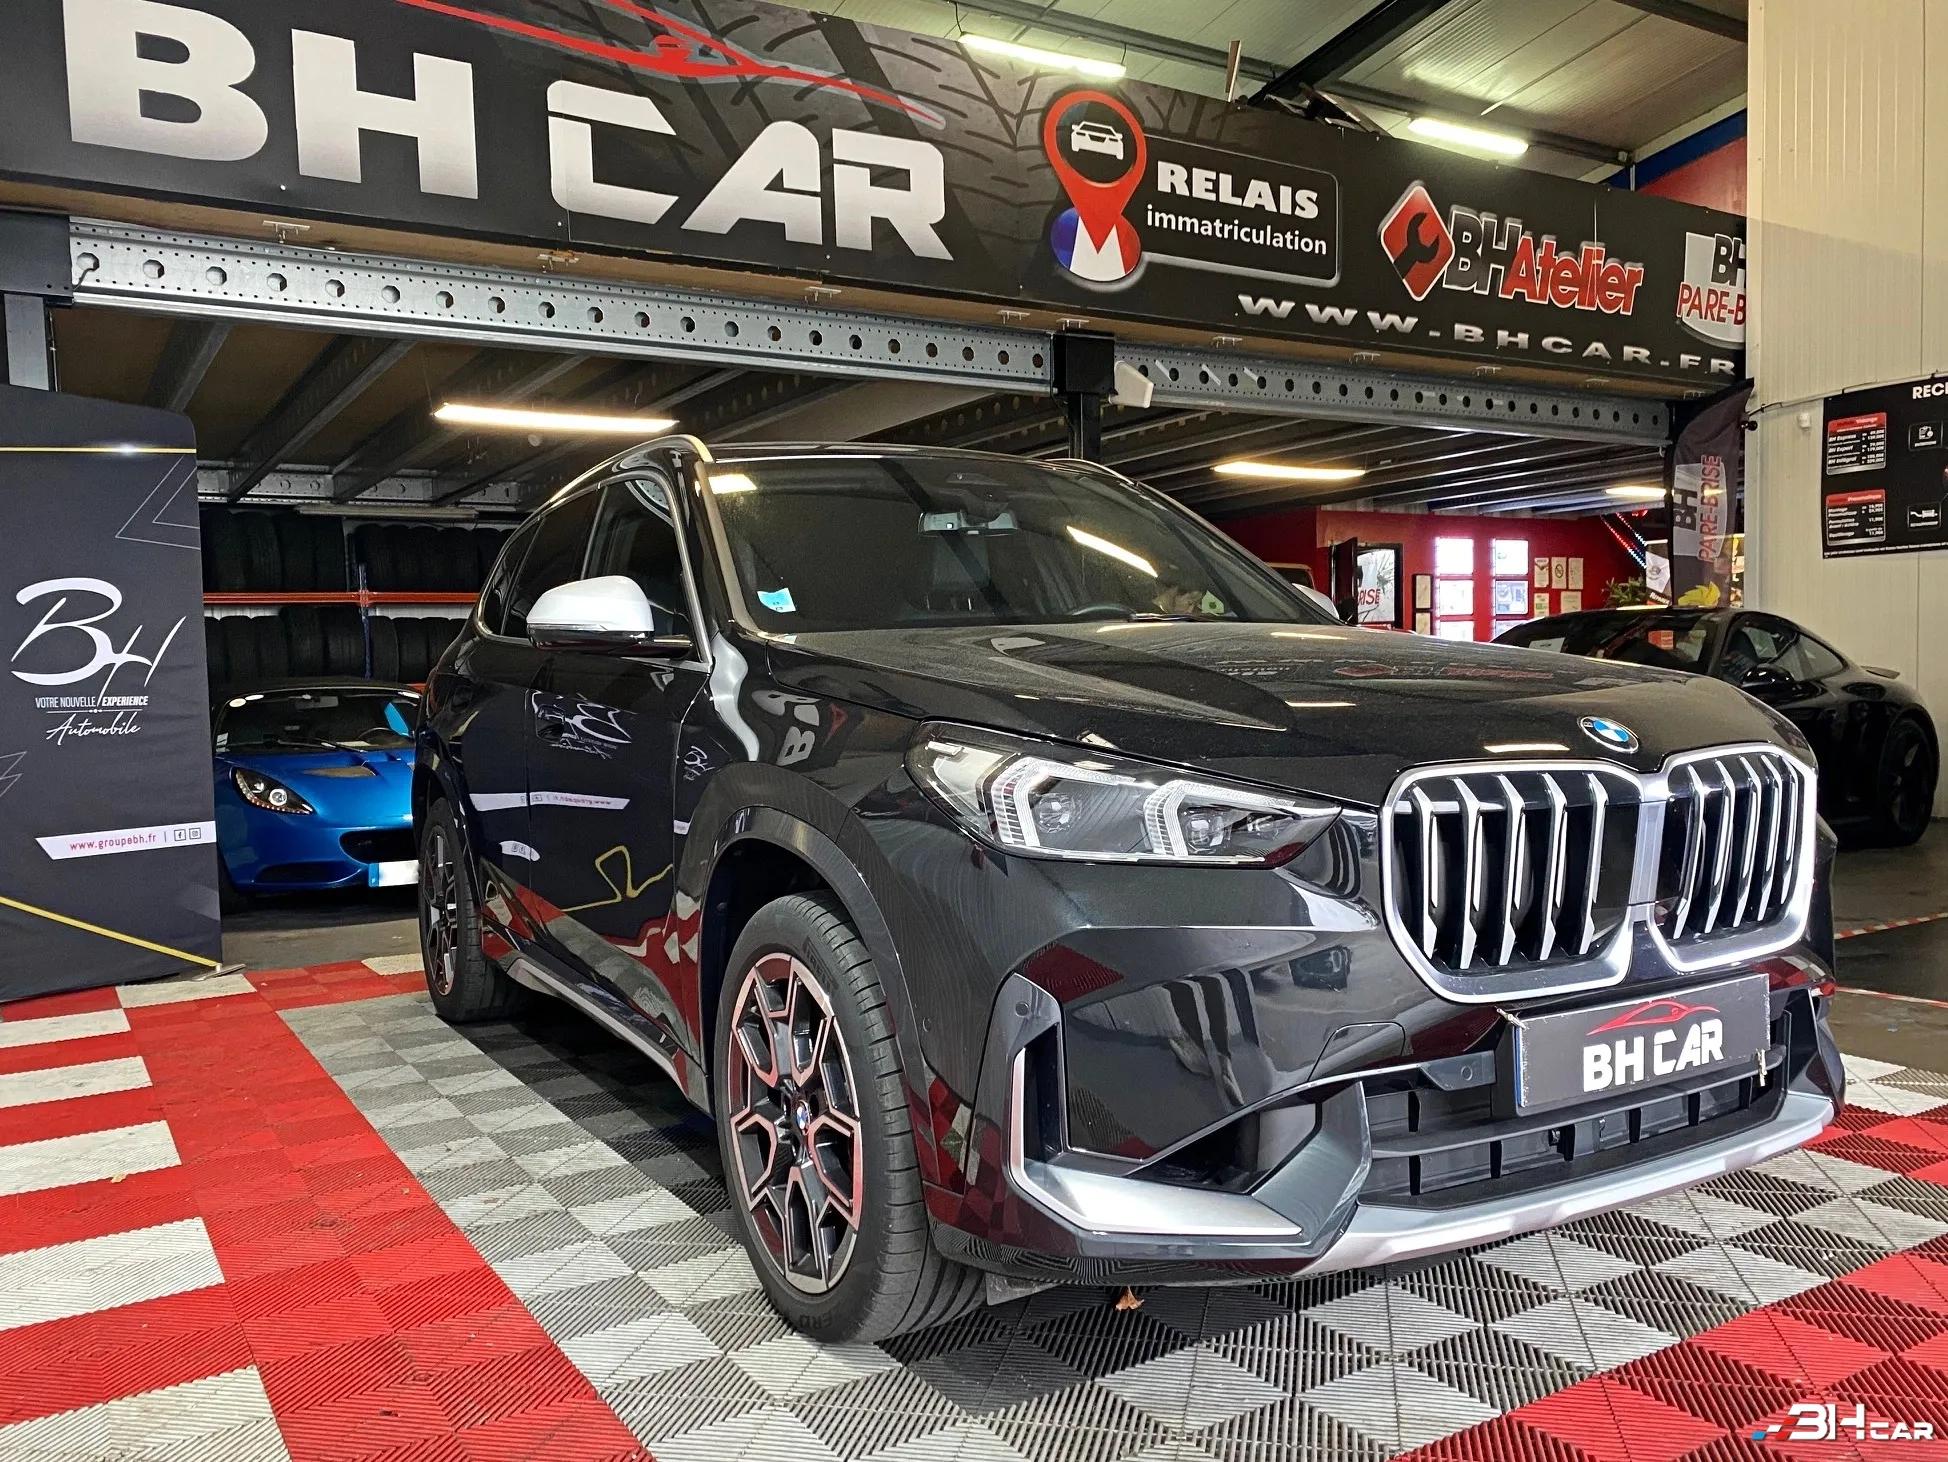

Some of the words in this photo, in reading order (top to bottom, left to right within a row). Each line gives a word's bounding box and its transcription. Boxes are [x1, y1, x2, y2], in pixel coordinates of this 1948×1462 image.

[63, 0, 479, 200] BH
[546, 80, 954, 261] CAR
[1157, 160, 1319, 220] RELAIS
[1147, 203, 1327, 255] immatriculation
[1912, 381, 1948, 400] REC
[1673, 488, 1698, 531] BH
[1698, 455, 1721, 563] PARE-BRISE
[11, 577, 187, 706] BH
[35, 697, 60, 709] VOTRE
[60, 696, 97, 708] NOUVELLE
[101, 695, 149, 707] EXPERIENCE
[46, 711, 140, 746] Automobile
[69, 833, 157, 852] www.groupebh.fr
[1583, 1035, 1645, 1093] BH
[1653, 1018, 1724, 1077] CAR
